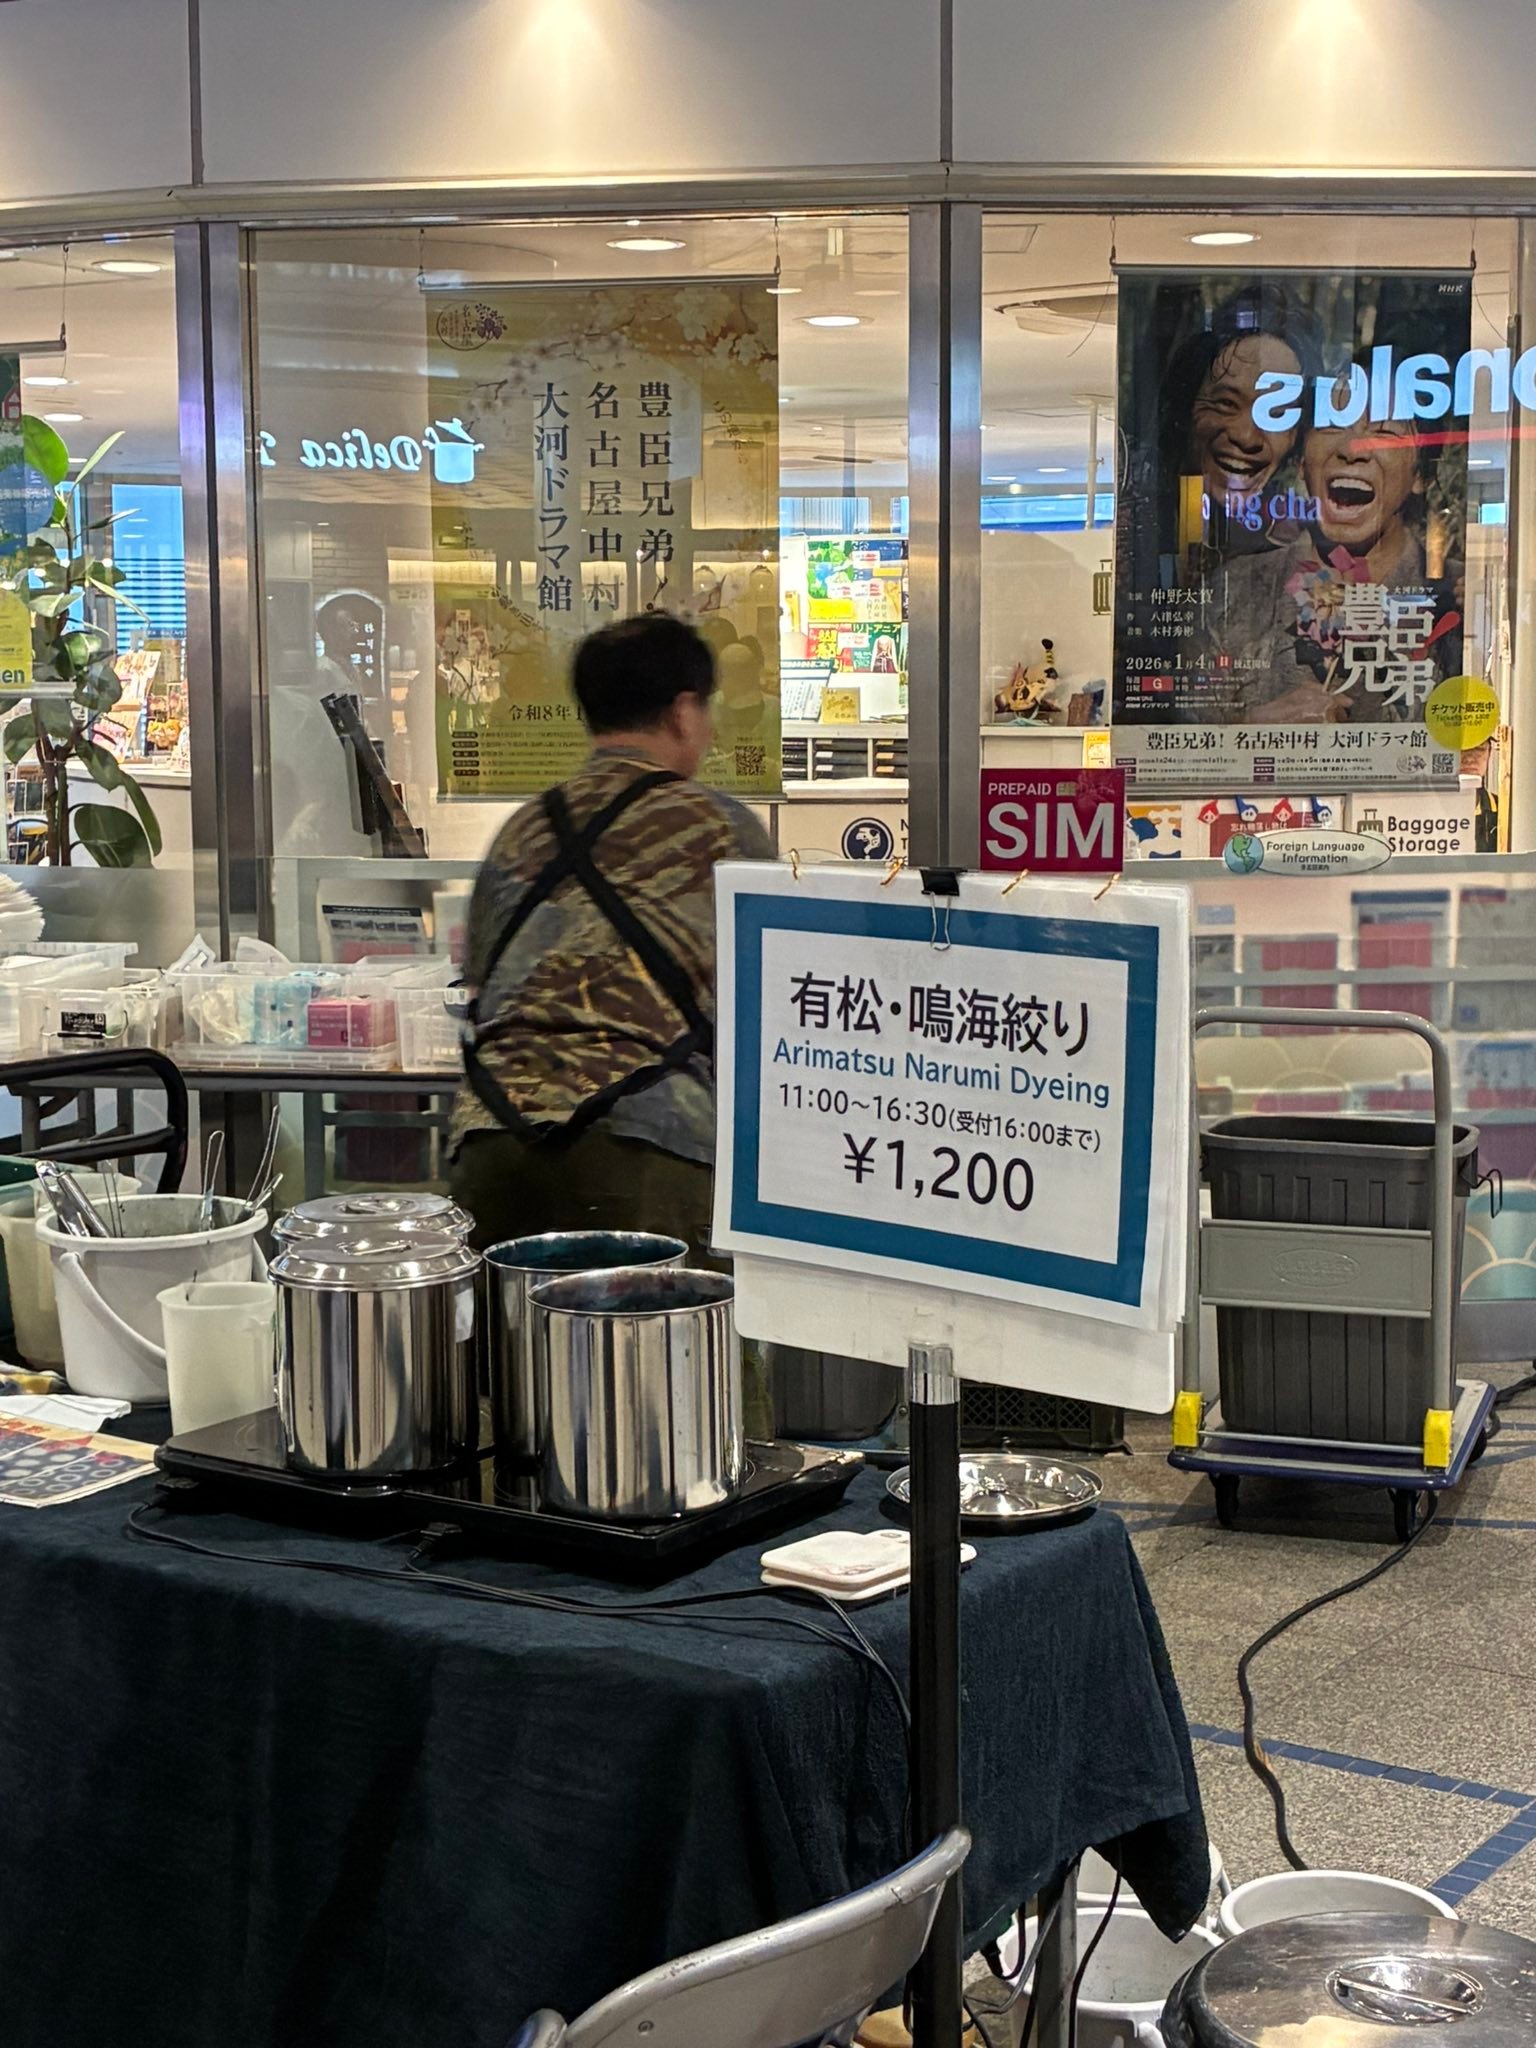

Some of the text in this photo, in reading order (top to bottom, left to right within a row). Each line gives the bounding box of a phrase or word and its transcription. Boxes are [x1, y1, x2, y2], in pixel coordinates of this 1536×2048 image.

[1438, 284, 1463, 293] NHK
[532, 381, 573, 612] 大河ドラマ館
[584, 381, 624, 611] 名古屋中村
[1152, 678, 1163, 690] G
[1431, 701, 1495, 715] チケット販売中
[1146, 729, 1428, 750] 豊臣兄弟! 名古屋中村 大河ドラマ館
[987, 782, 1052, 796] PREPAID
[985, 801, 1115, 859] SIM
[1387, 815, 1471, 836] Baggage
[1266, 840, 1365, 853] Foreign Language
[1388, 836, 1461, 854] Storage
[1281, 852, 1349, 865] Information
[789, 970, 1090, 1058] 有松・鳴海絞り
[773, 1037, 1111, 1108] Arimatsu Narumi Dyeing
[843, 1132, 1035, 1213] ¥1,200
